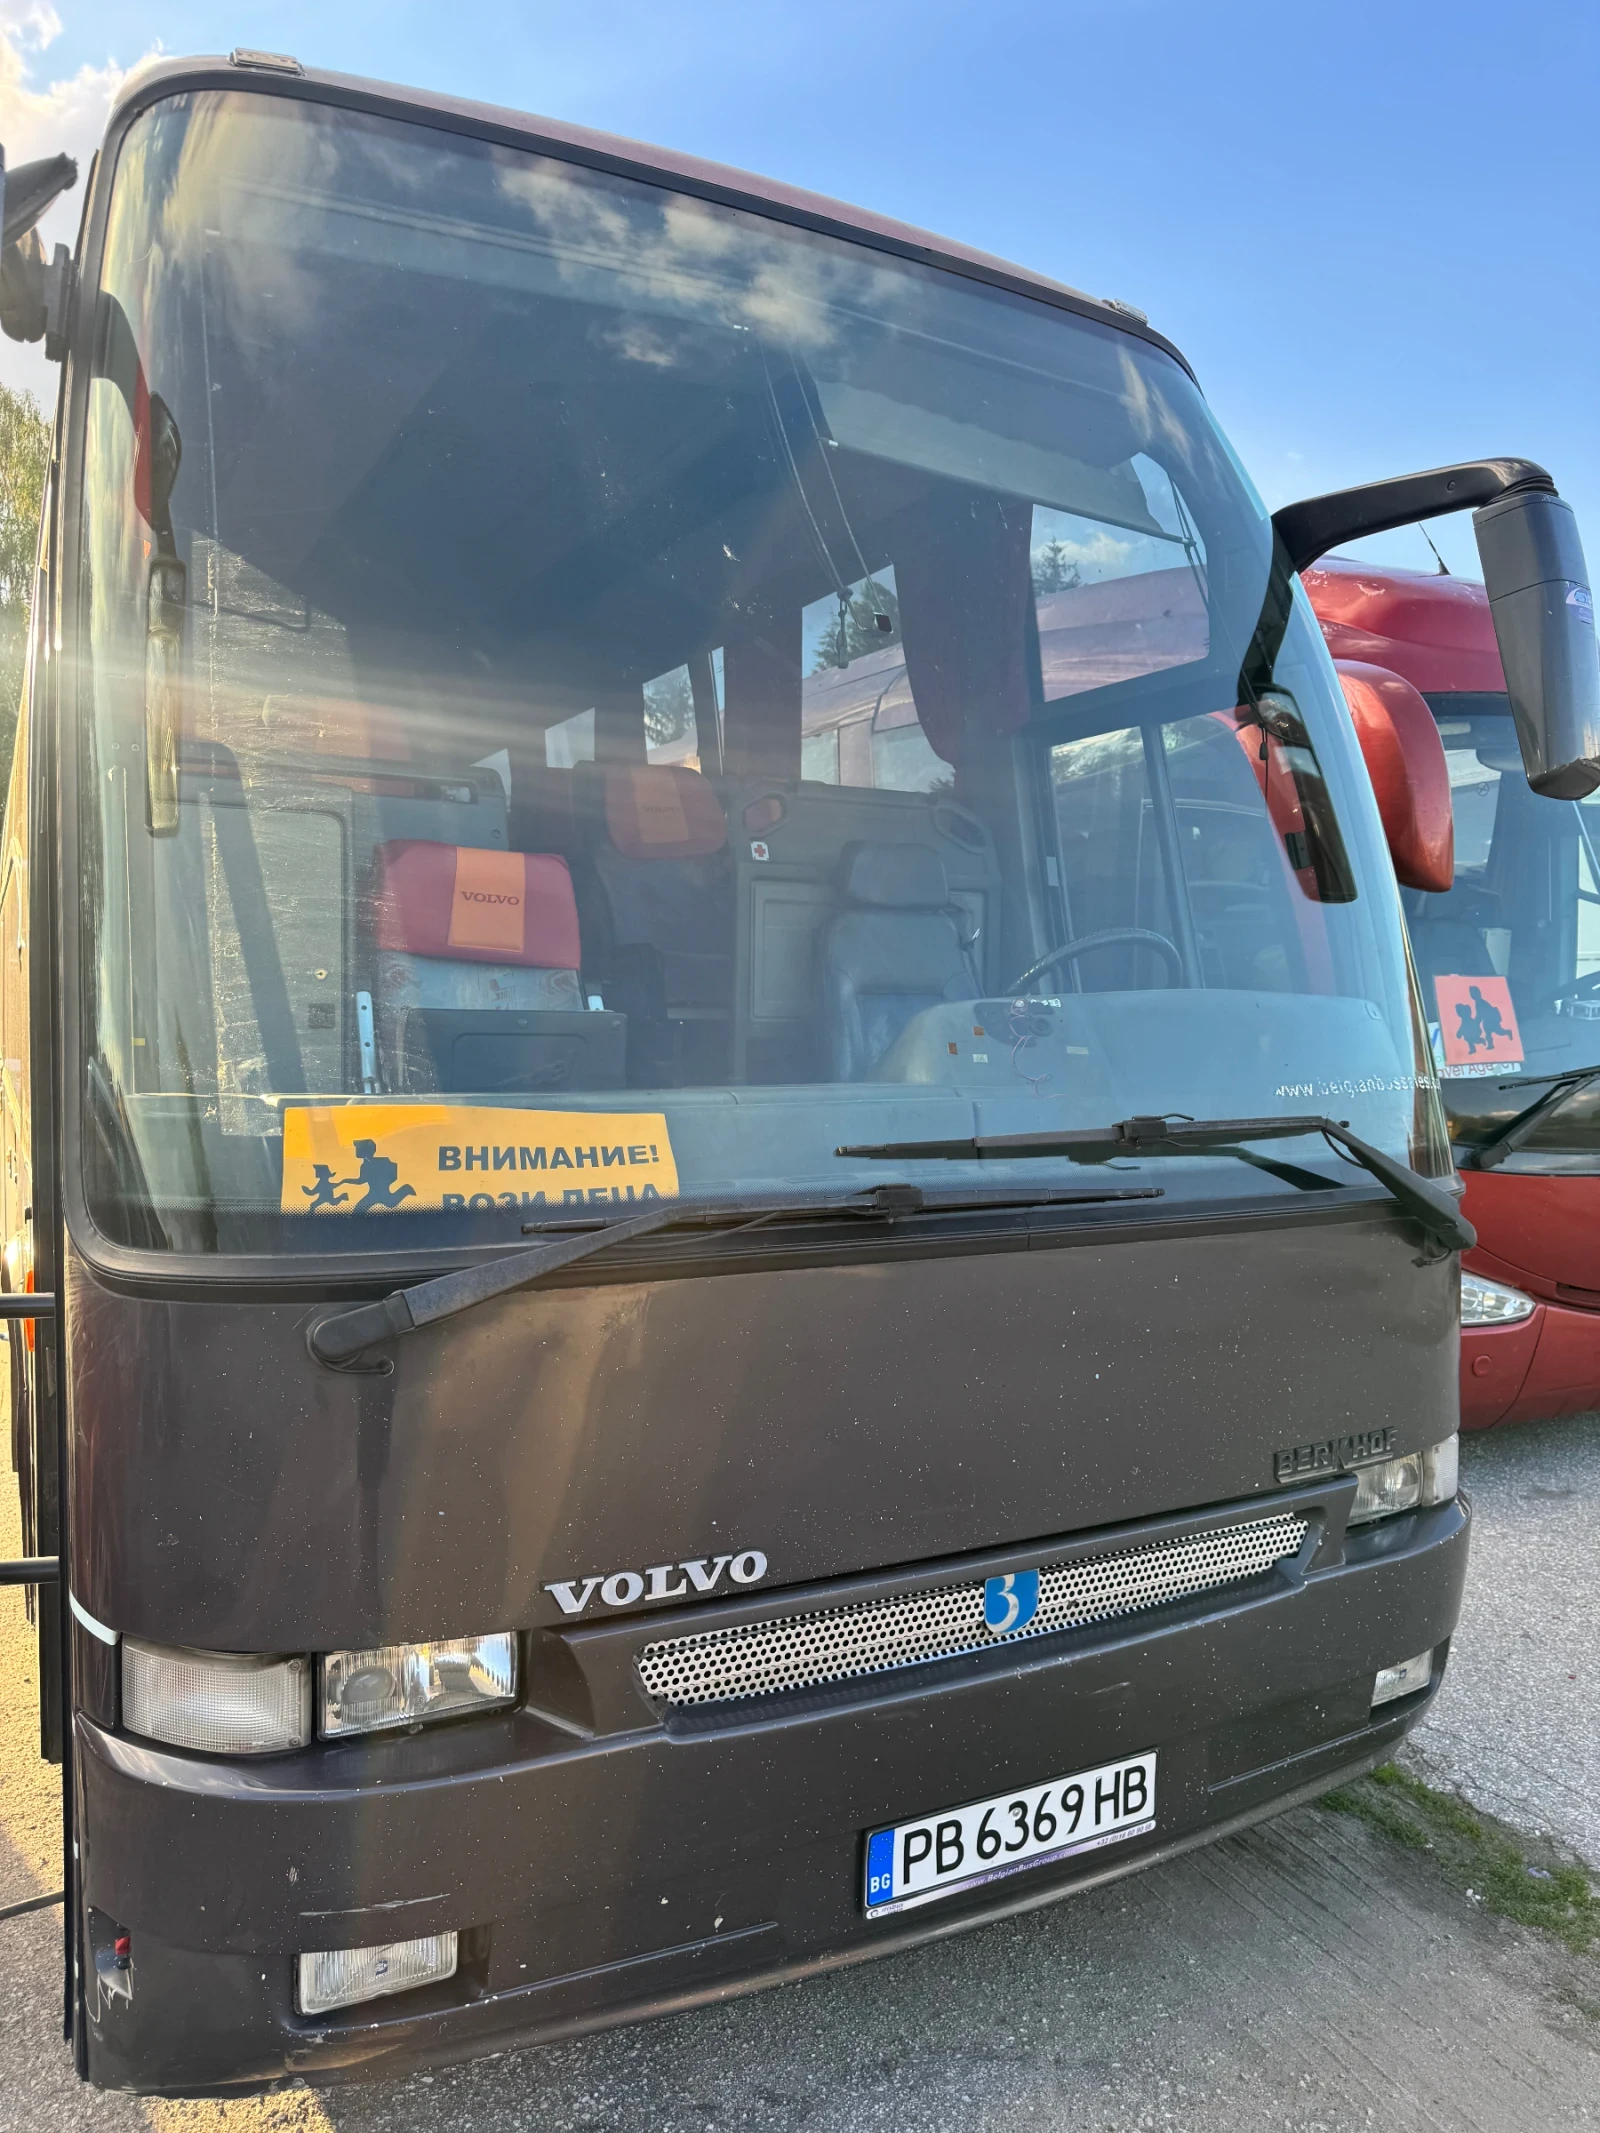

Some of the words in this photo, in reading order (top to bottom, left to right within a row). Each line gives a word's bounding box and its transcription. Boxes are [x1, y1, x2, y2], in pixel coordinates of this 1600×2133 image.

[461, 890, 520, 906] VOLVO
[438, 1144, 660, 1171] ВНИМАНИЕ!
[1274, 1426, 1398, 1482] BERKHOF
[543, 1549, 768, 1614] VOLVO
[976, 1783, 1085, 1860] 6369
[870, 1873, 890, 1893] BG
[962, 1849, 1077, 1889] www.BelgianBusGroup.com
